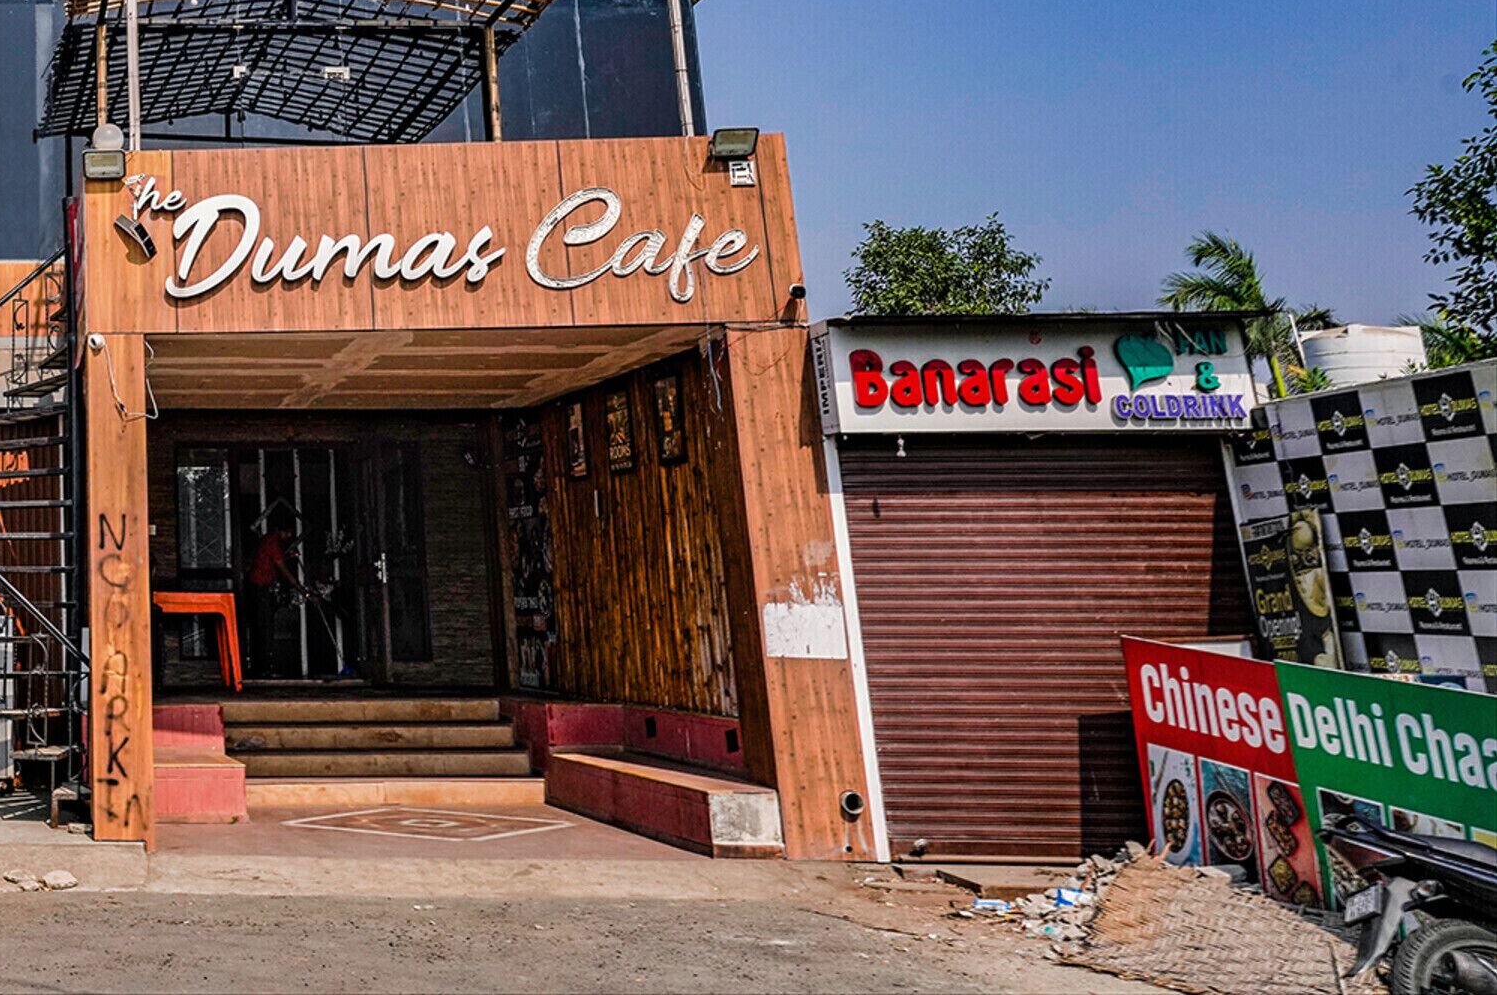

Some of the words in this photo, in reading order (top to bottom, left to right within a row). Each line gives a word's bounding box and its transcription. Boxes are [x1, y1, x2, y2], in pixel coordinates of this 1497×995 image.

[165, 194, 505, 299] Dumas
[526, 187, 759, 303] Cafe
[849, 346, 1103, 407] Banarasi
[1196, 361, 1222, 392] &
[1115, 394, 1248, 418] COLDRINK
[1256, 584, 1293, 614] Grand
[1139, 663, 1286, 754] Chinese
[1287, 692, 1394, 768] Delhi
